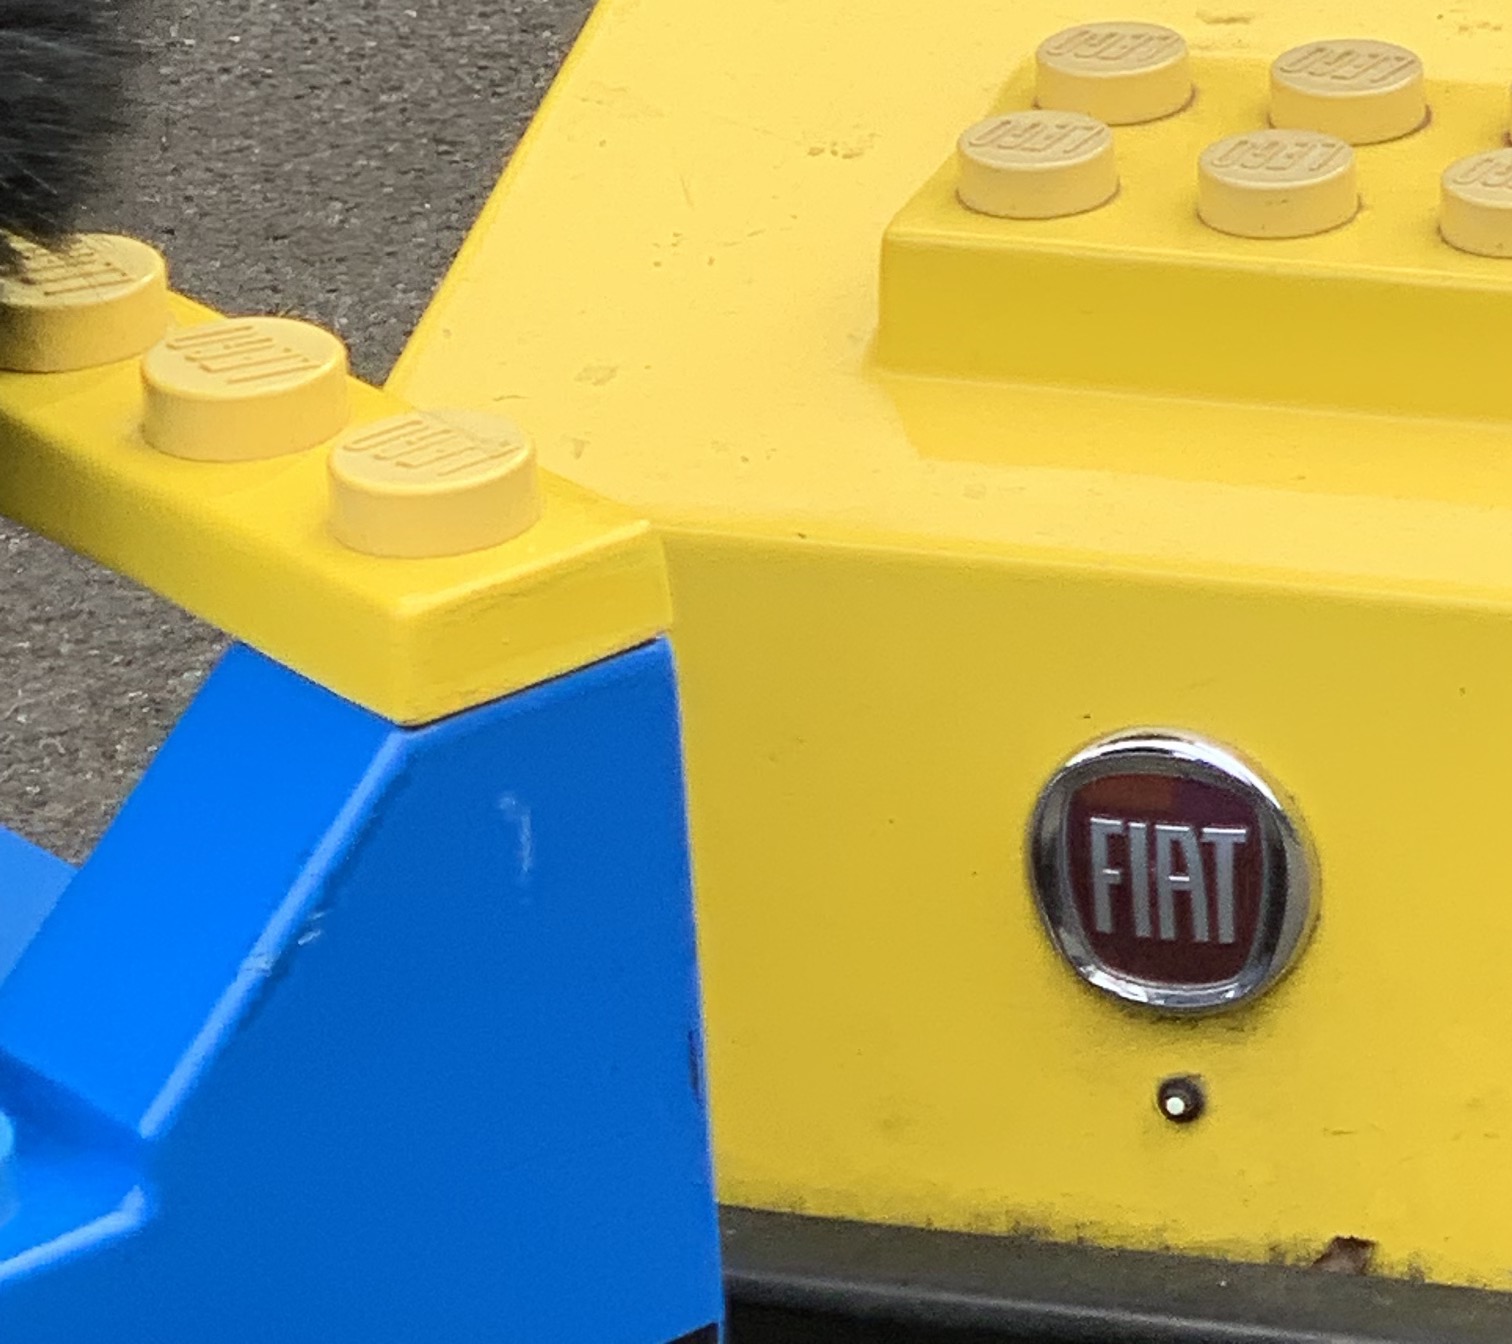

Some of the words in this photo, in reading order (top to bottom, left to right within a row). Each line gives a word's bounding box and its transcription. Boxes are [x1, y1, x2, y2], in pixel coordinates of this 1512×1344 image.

[1046, 31, 1181, 63] LEGO
[1280, 48, 1416, 84] LEGO
[969, 120, 1105, 153] LEGO
[1210, 139, 1345, 173] LEGO
[1089, 817, 1247, 944] FIAT
